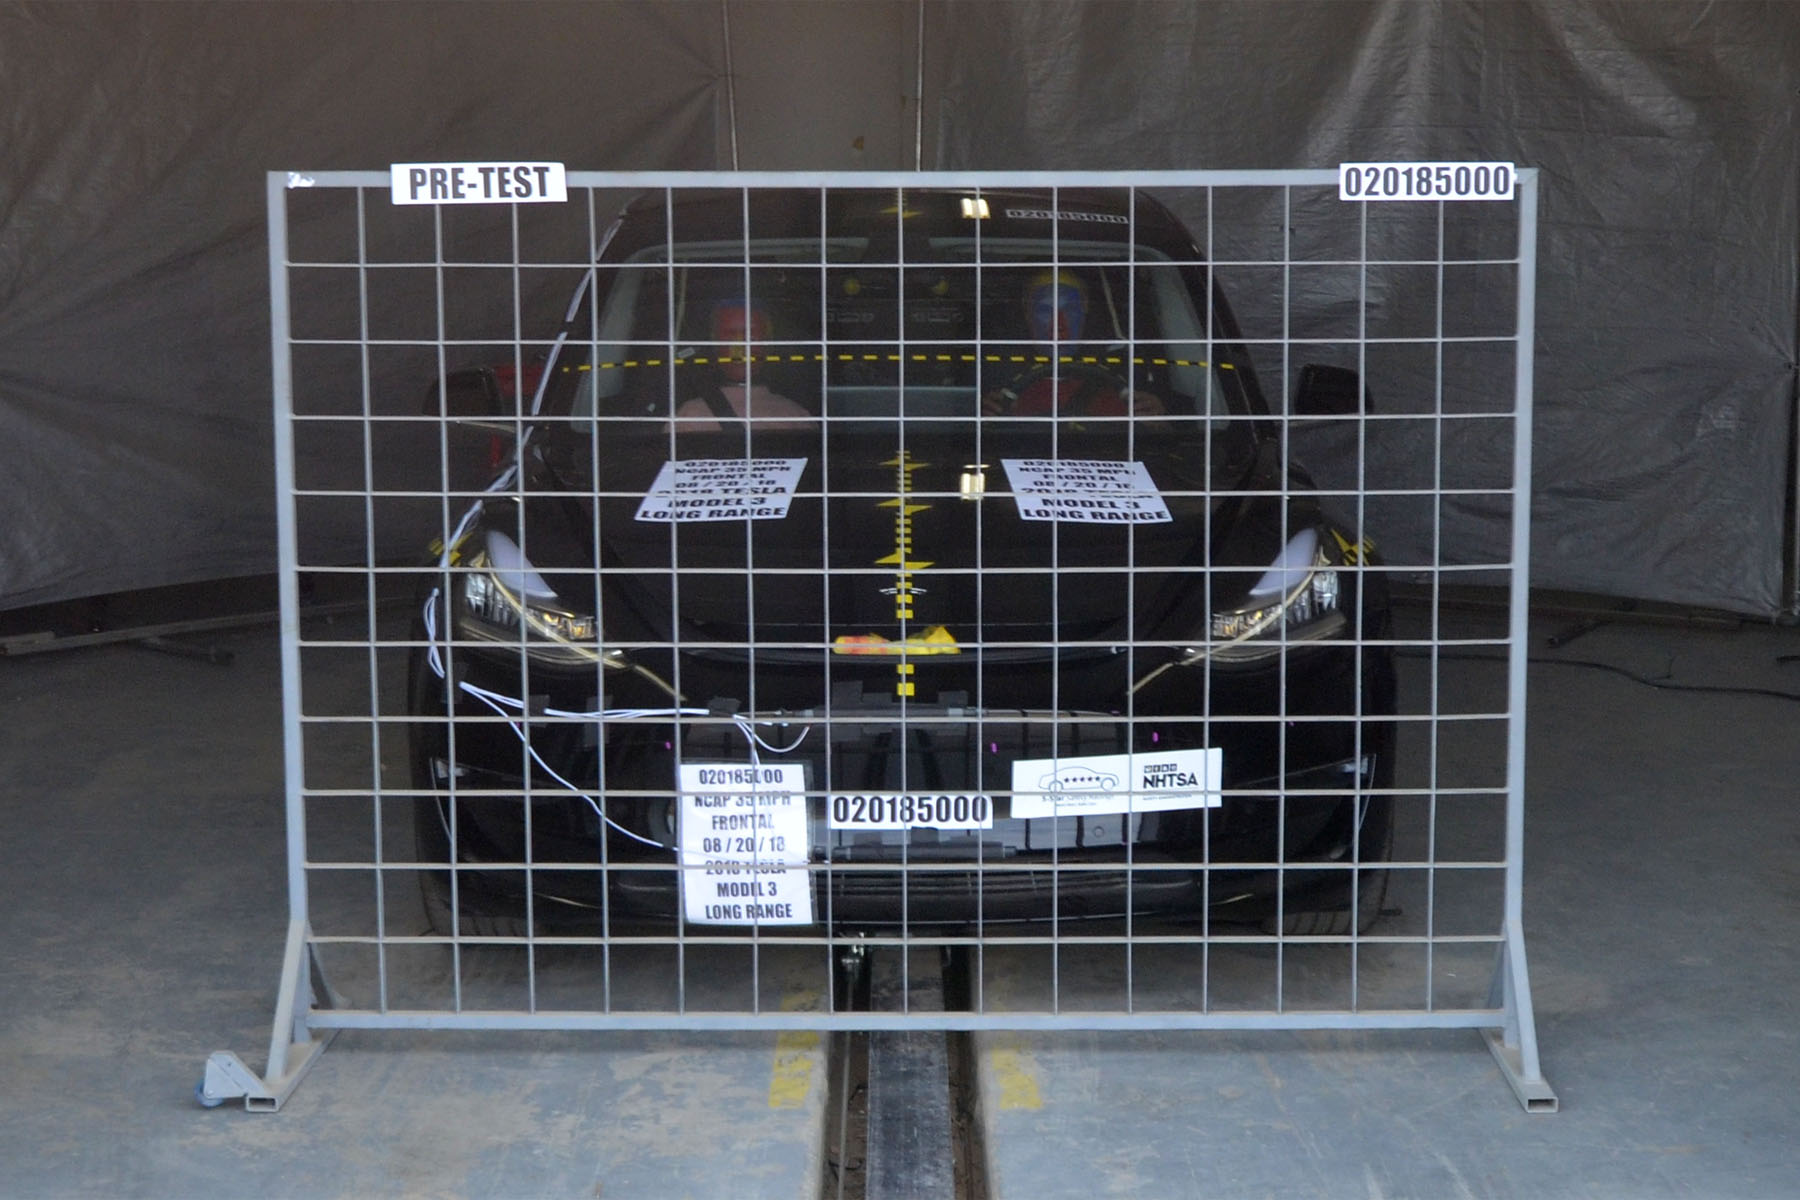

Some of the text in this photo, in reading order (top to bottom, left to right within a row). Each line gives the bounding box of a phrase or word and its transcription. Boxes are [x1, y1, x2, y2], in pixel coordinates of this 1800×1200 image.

[409, 166, 550, 200] PRE-TEST
[1345, 166, 1509, 196] 020185000
[1007, 210, 1126, 223] 02085000
[668, 498, 746, 508] MODEL
[1041, 498, 1120, 509] MODEL
[641, 507, 786, 519] LONG RANGE
[1023, 509, 1169, 520] LONG RANGE
[1143, 772, 1199, 789] NHTSA
[833, 796, 988, 823] 020185000
[712, 814, 775, 830] FRONTAL
[703, 837, 722, 854] 08
[736, 837, 754, 853] 20
[769, 836, 786, 852] 18
[768, 881, 778, 897] 3
[705, 903, 793, 920] LONG RANGE
